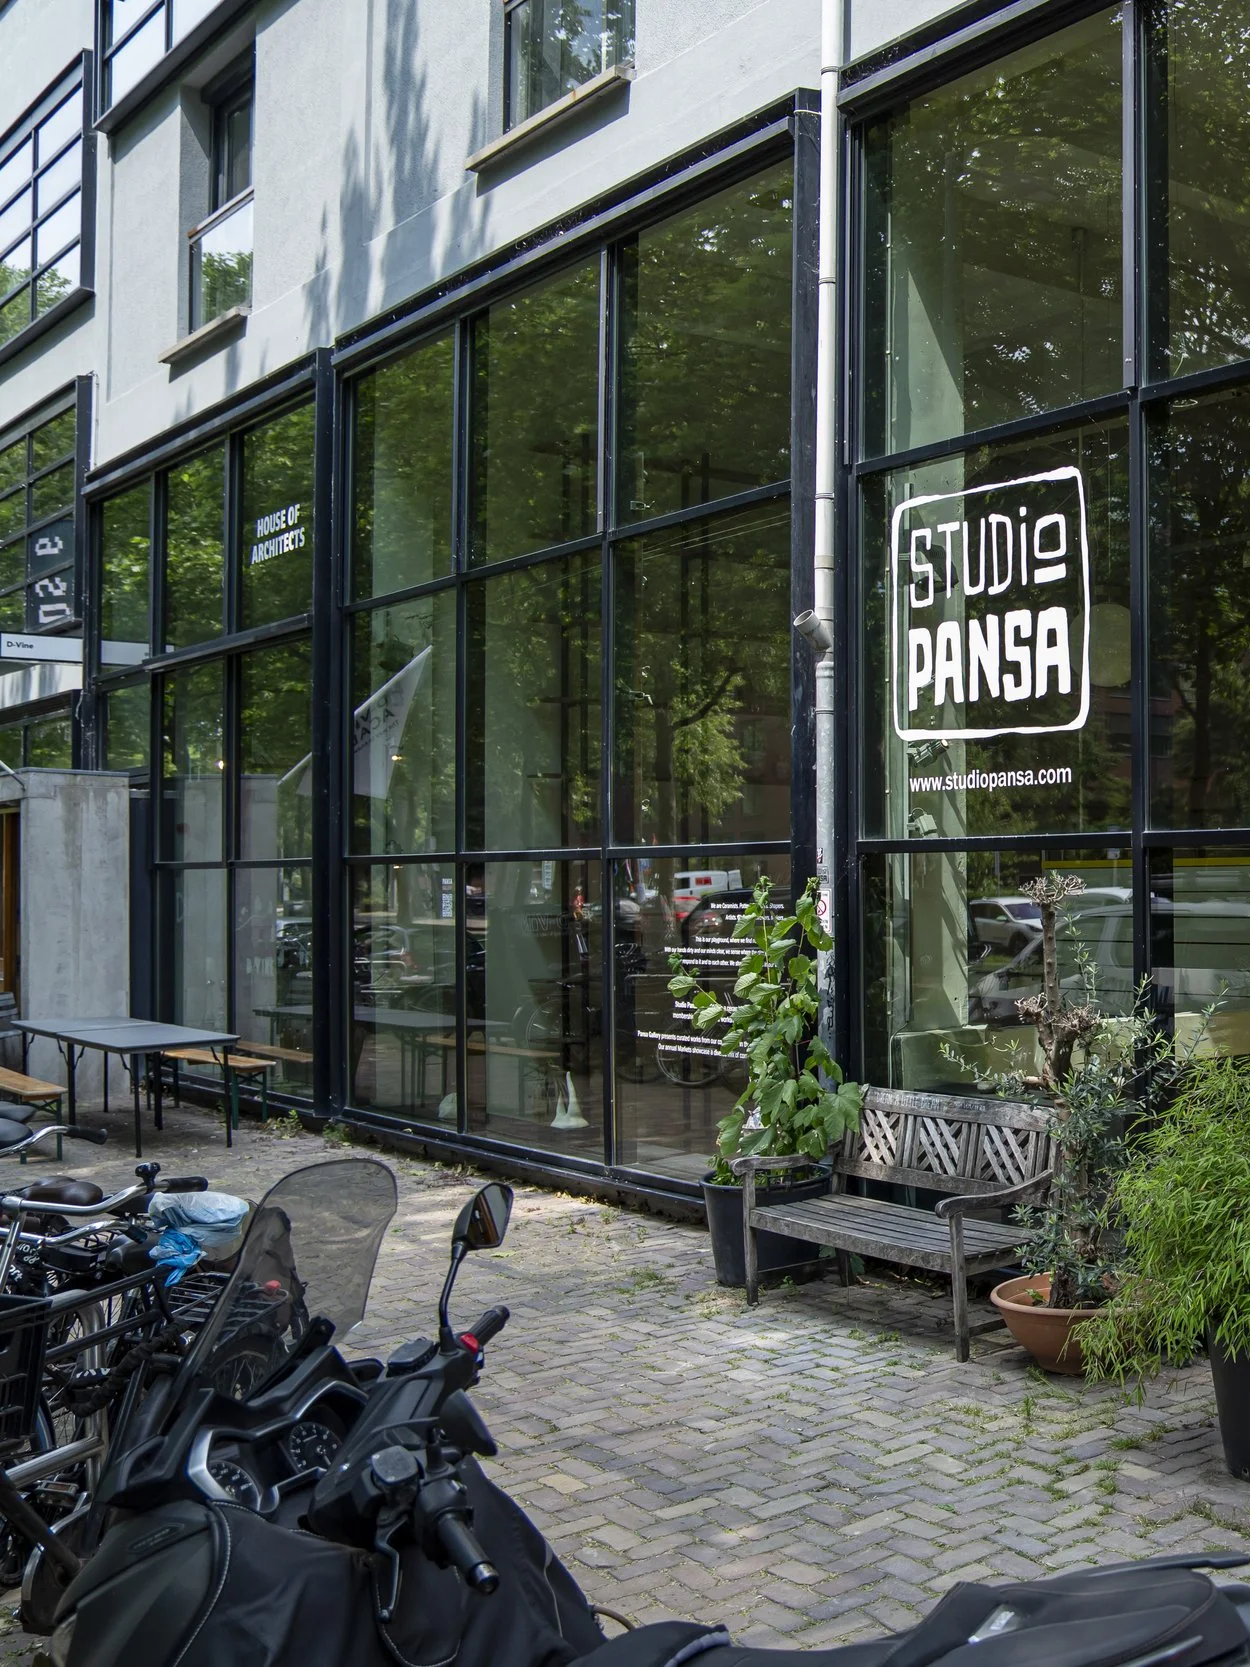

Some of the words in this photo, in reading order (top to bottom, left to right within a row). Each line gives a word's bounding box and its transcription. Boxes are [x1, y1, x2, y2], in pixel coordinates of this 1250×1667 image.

[257, 509, 286, 538] HOUSE
[287, 503, 300, 526] OF
[251, 527, 305, 564] ARCHITECTS
[6, 641, 34, 650] D-Vine
[908, 606, 1072, 712] PANSA
[909, 767, 1072, 792] www.studiopansa.com
